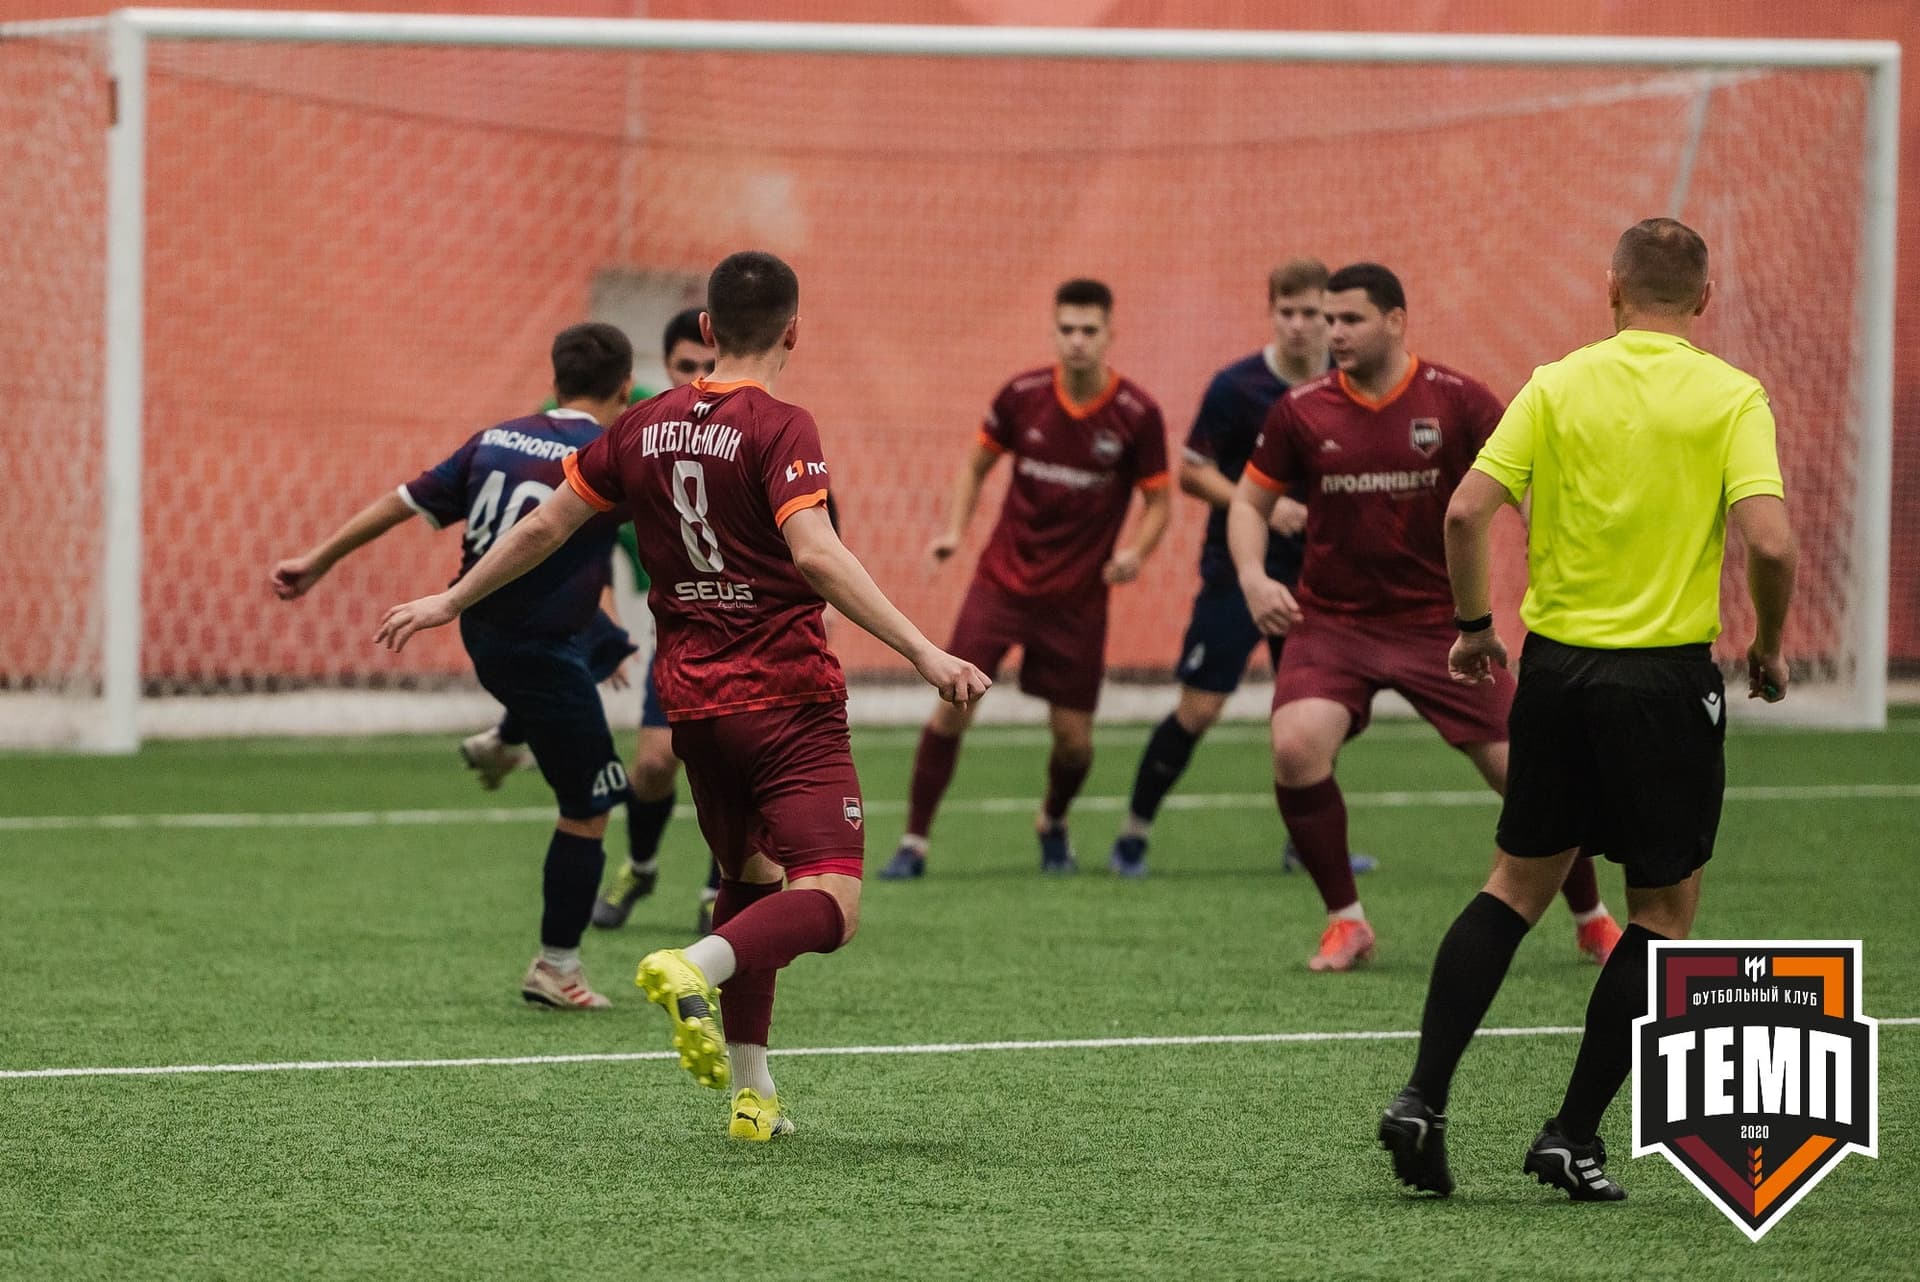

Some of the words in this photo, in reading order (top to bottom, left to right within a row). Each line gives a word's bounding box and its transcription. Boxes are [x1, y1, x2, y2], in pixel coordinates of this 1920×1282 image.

[673, 460, 725, 574] 8
[674, 580, 754, 601] SEUS
[591, 760, 628, 797] 40
